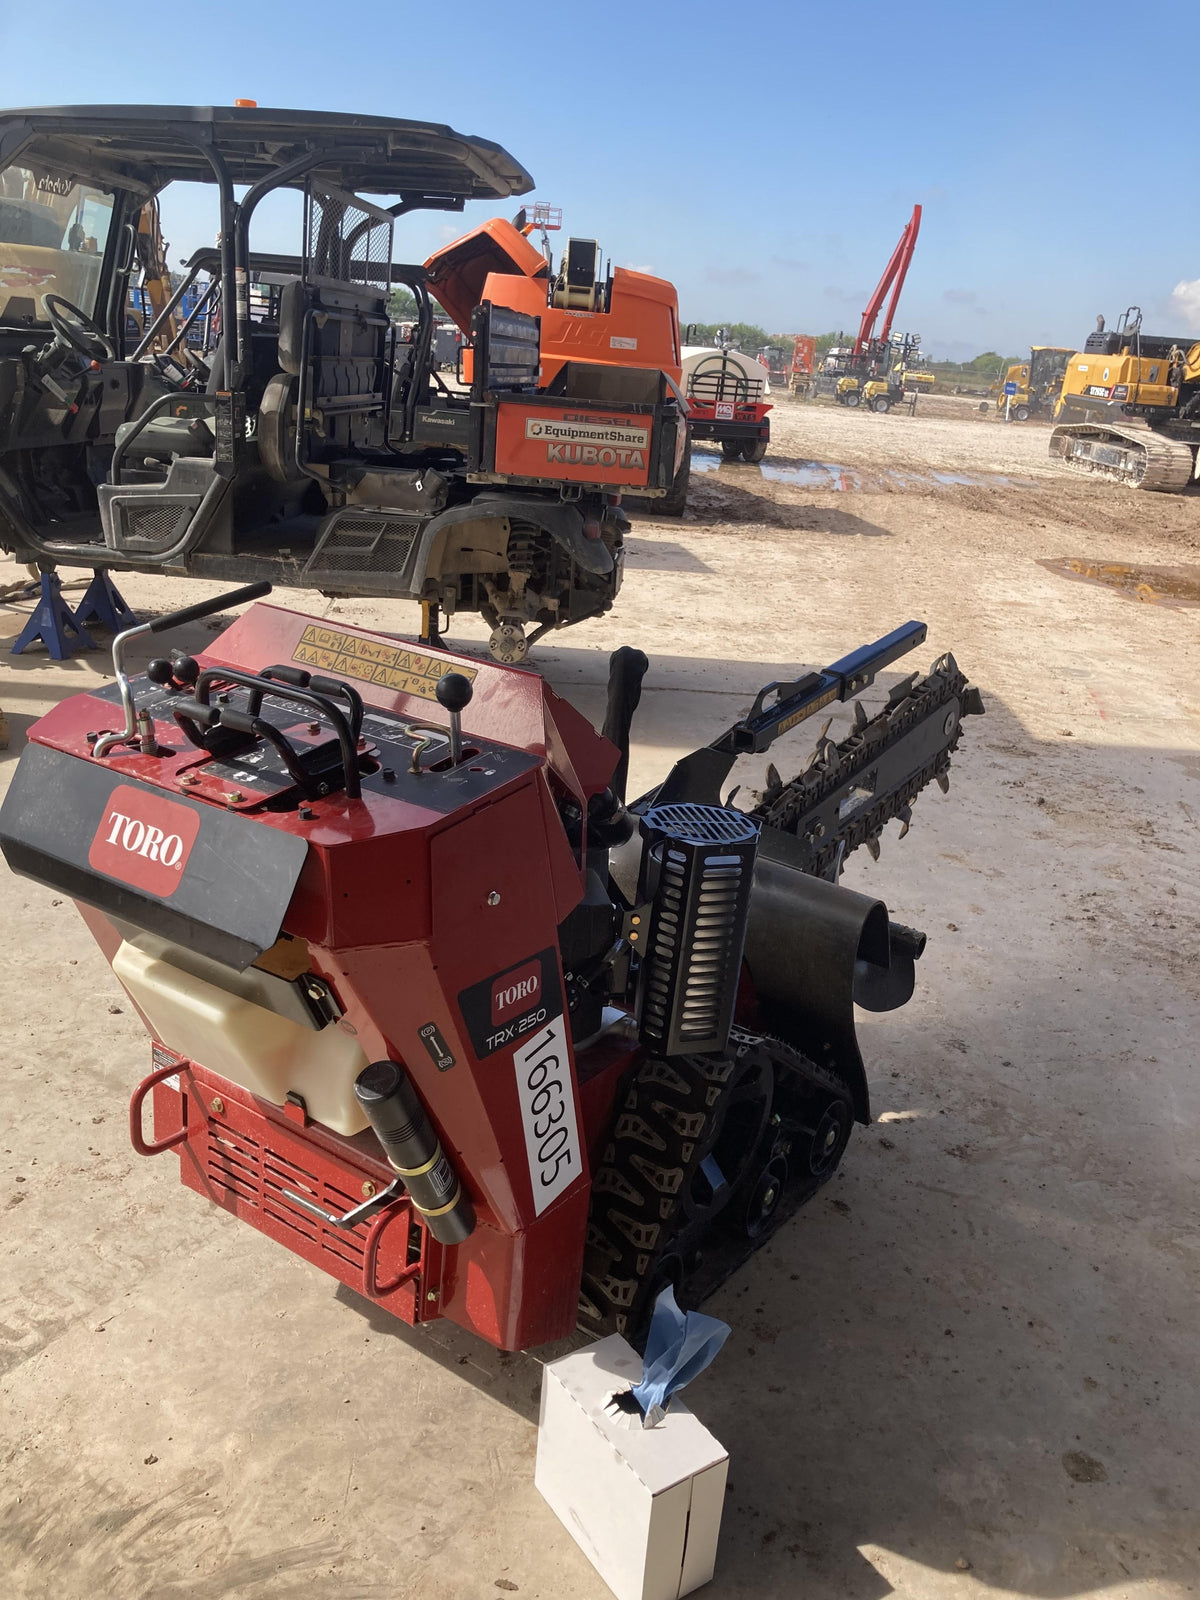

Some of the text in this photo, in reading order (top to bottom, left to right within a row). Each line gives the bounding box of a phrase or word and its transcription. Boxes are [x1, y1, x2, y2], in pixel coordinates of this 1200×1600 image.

[422, 415, 456, 426] Kawasaki
[544, 425, 645, 444] EquipmentShare
[546, 443, 646, 470] KUBOTA
[105, 811, 183, 867] TORO
[495, 975, 538, 1011] TORO
[524, 1028, 573, 1187] 166305
